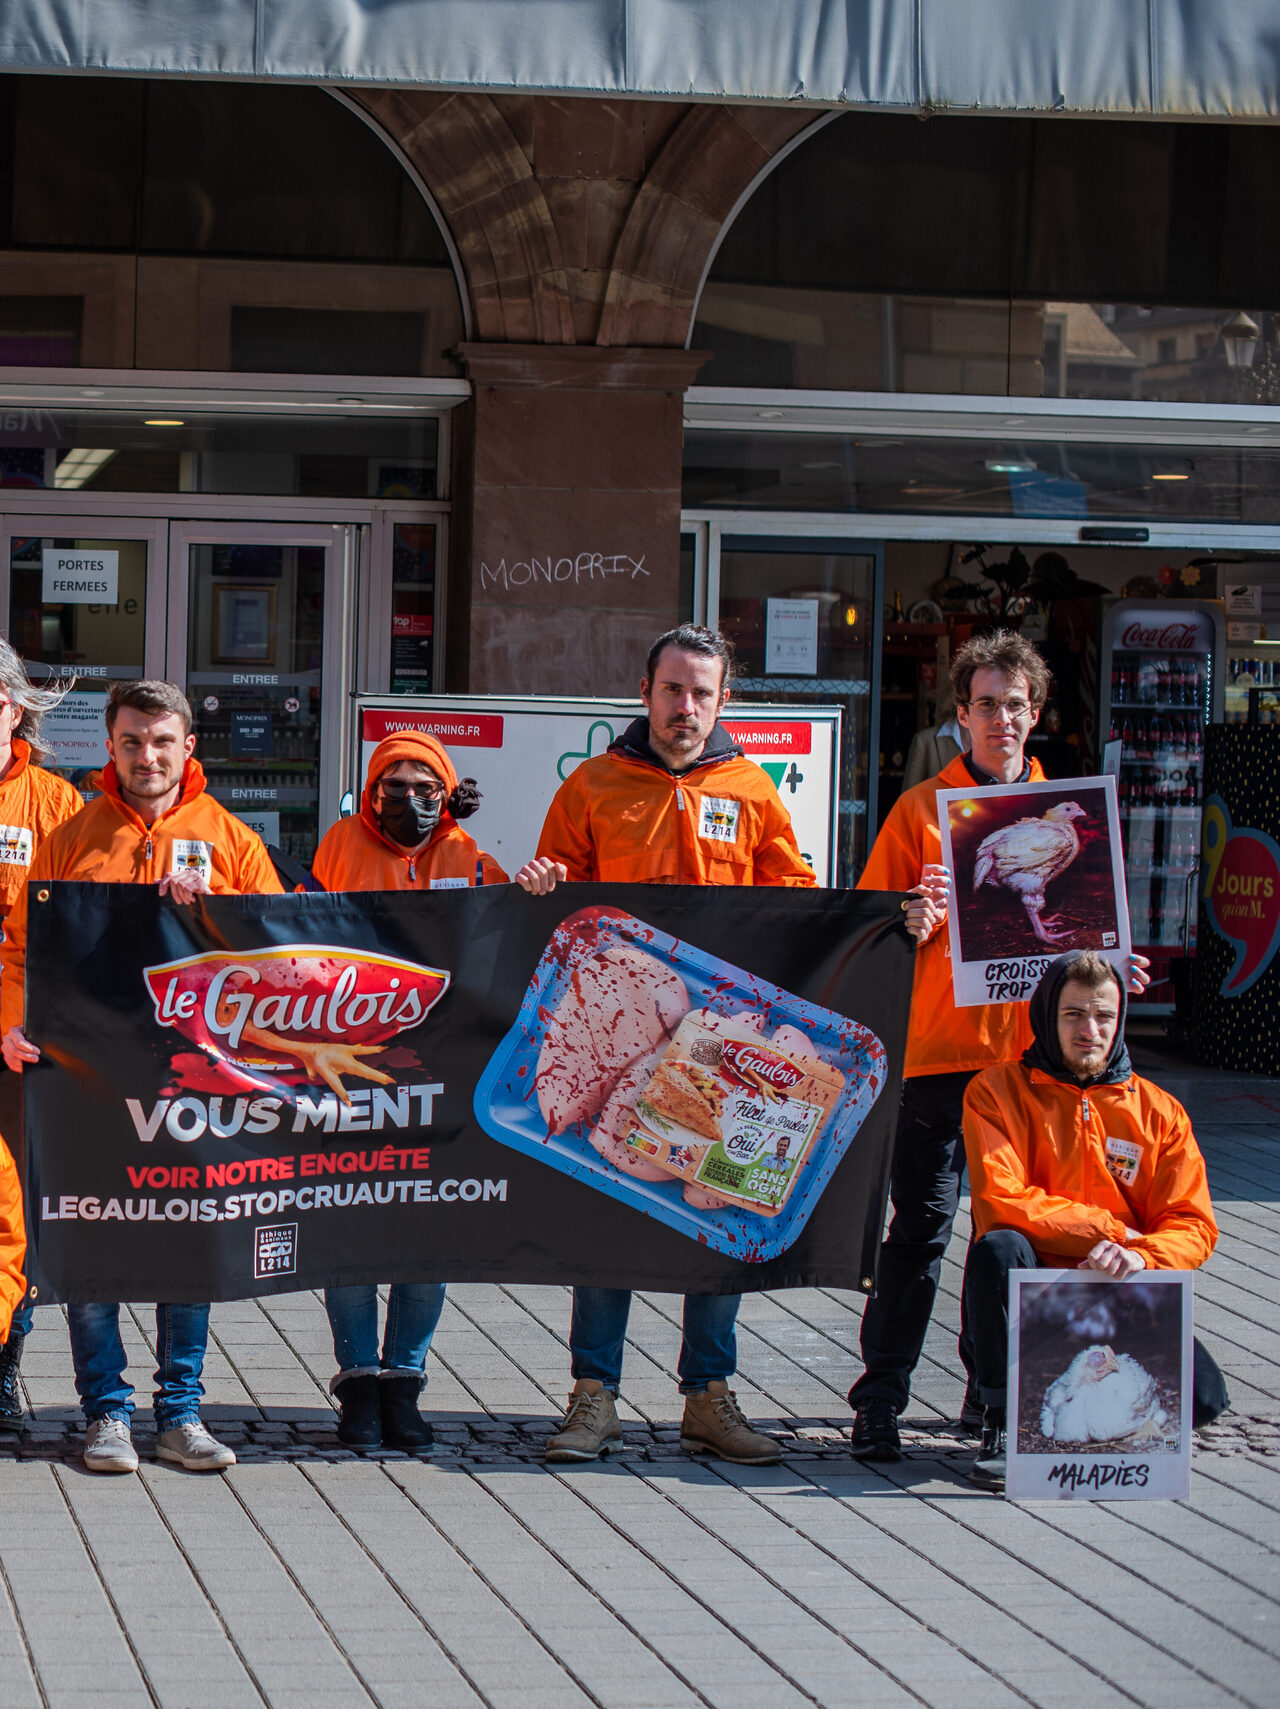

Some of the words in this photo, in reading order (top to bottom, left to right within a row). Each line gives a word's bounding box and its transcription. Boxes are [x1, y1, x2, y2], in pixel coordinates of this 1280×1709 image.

[58, 559, 104, 571] PORTES
[480, 552, 651, 591] MONOPRIX
[53, 580, 108, 592] FERMEES
[1121, 621, 1200, 649] Coca-Cola
[61, 666, 108, 676] ENTREE
[232, 674, 279, 684] ENTREE
[384, 721, 480, 736] WWWWARNING.FR
[730, 732, 793, 744] .WARNING.FR
[231, 788, 278, 799] ENTREE
[704, 824, 731, 837] L214
[1203, 804, 1227, 898] 9
[1217, 867, 1274, 898] Jours
[985, 959, 1051, 982] CROISS
[986, 982, 1031, 1000] TROP
[162, 977, 195, 1019] le
[206, 966, 423, 1049] Gaulois
[723, 1042, 737, 1057] le
[735, 1046, 798, 1086] Gaulois
[125, 1096, 281, 1144] VOUS
[291, 1083, 445, 1133] MENT
[126, 1165, 200, 1189] VOIR
[206, 1156, 296, 1188] NOTRE
[300, 1145, 431, 1177] ENQUÊTE
[751, 1168, 787, 1186] SANS
[747, 1180, 782, 1197] OGM
[41, 1178, 508, 1222] LEGAULOIS.STOPCRUAUTE.COM
[260, 1230, 292, 1239] éthique
[260, 1255, 291, 1271] L214
[1047, 1460, 1150, 1491] MALADIES
